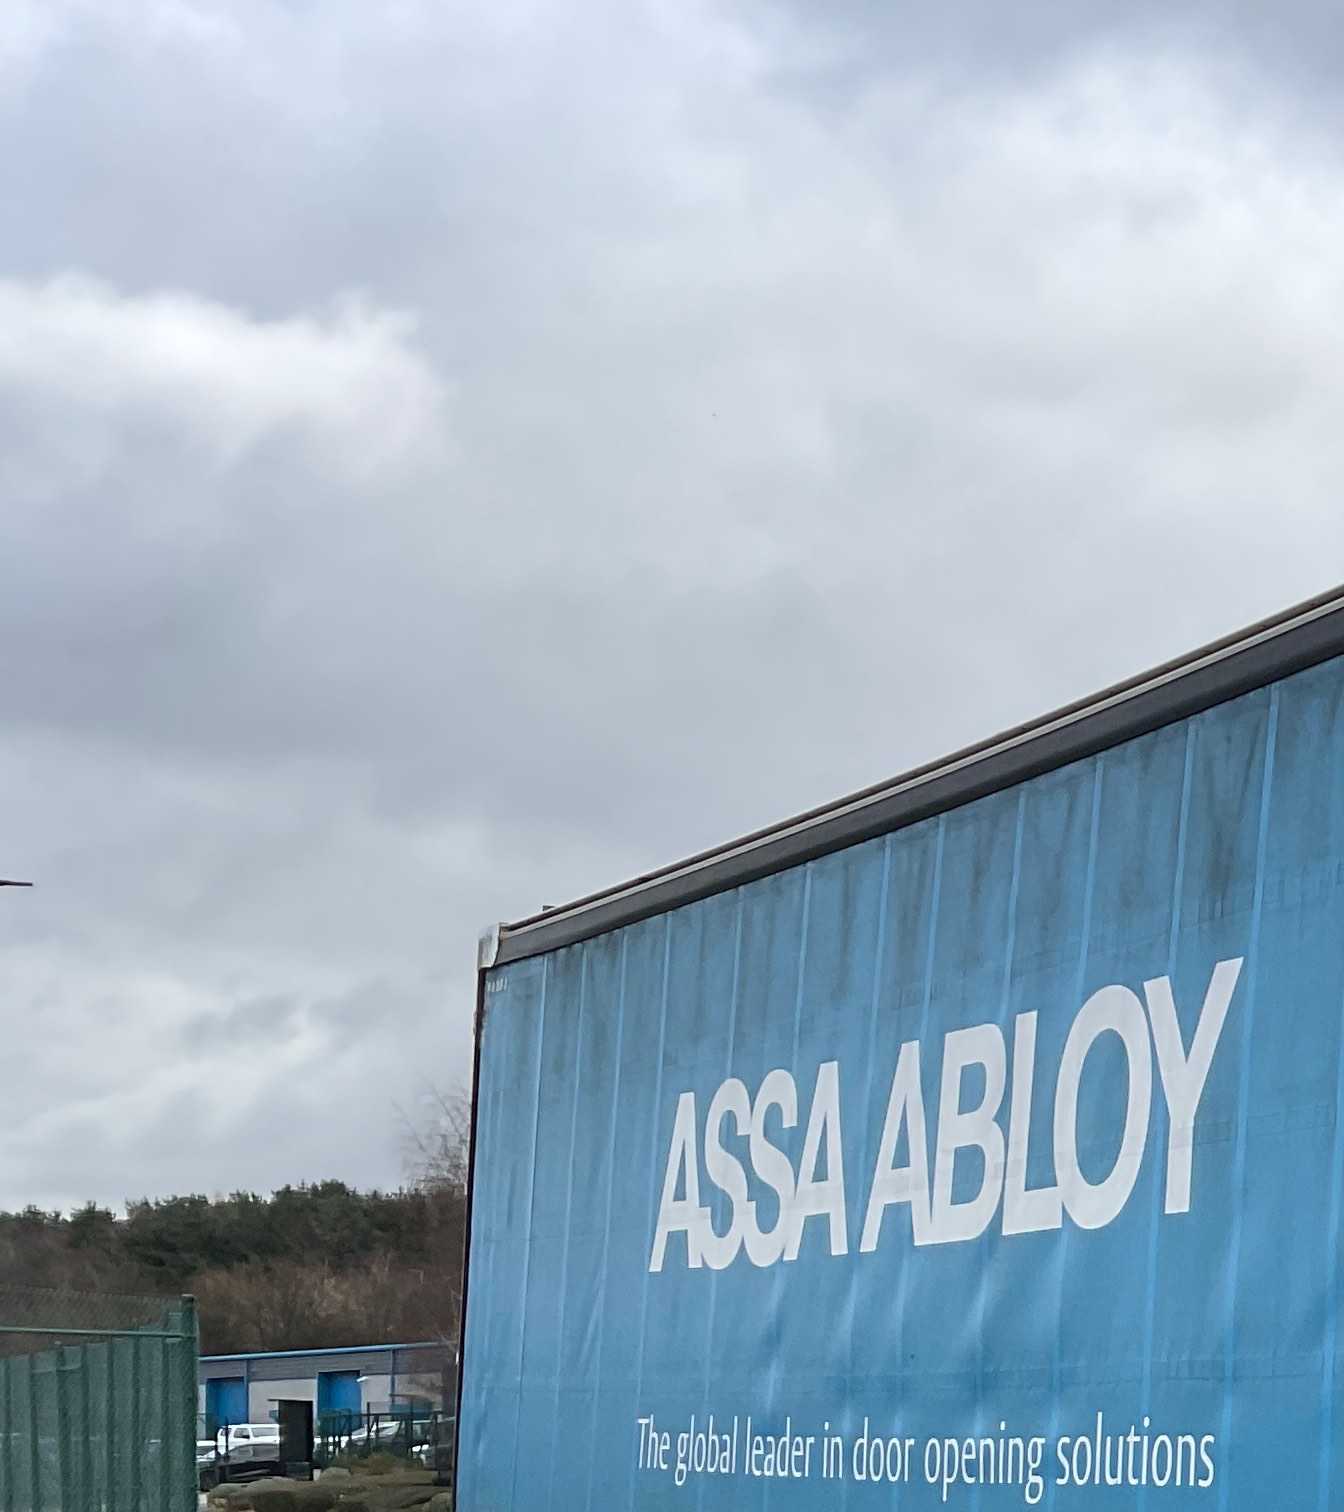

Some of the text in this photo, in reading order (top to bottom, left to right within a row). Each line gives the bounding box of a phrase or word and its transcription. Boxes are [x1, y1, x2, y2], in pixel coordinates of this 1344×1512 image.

[648, 956, 1245, 1274] ASSA ABLOY
[637, 1411, 1216, 1504] The global leader in door opening solutions
